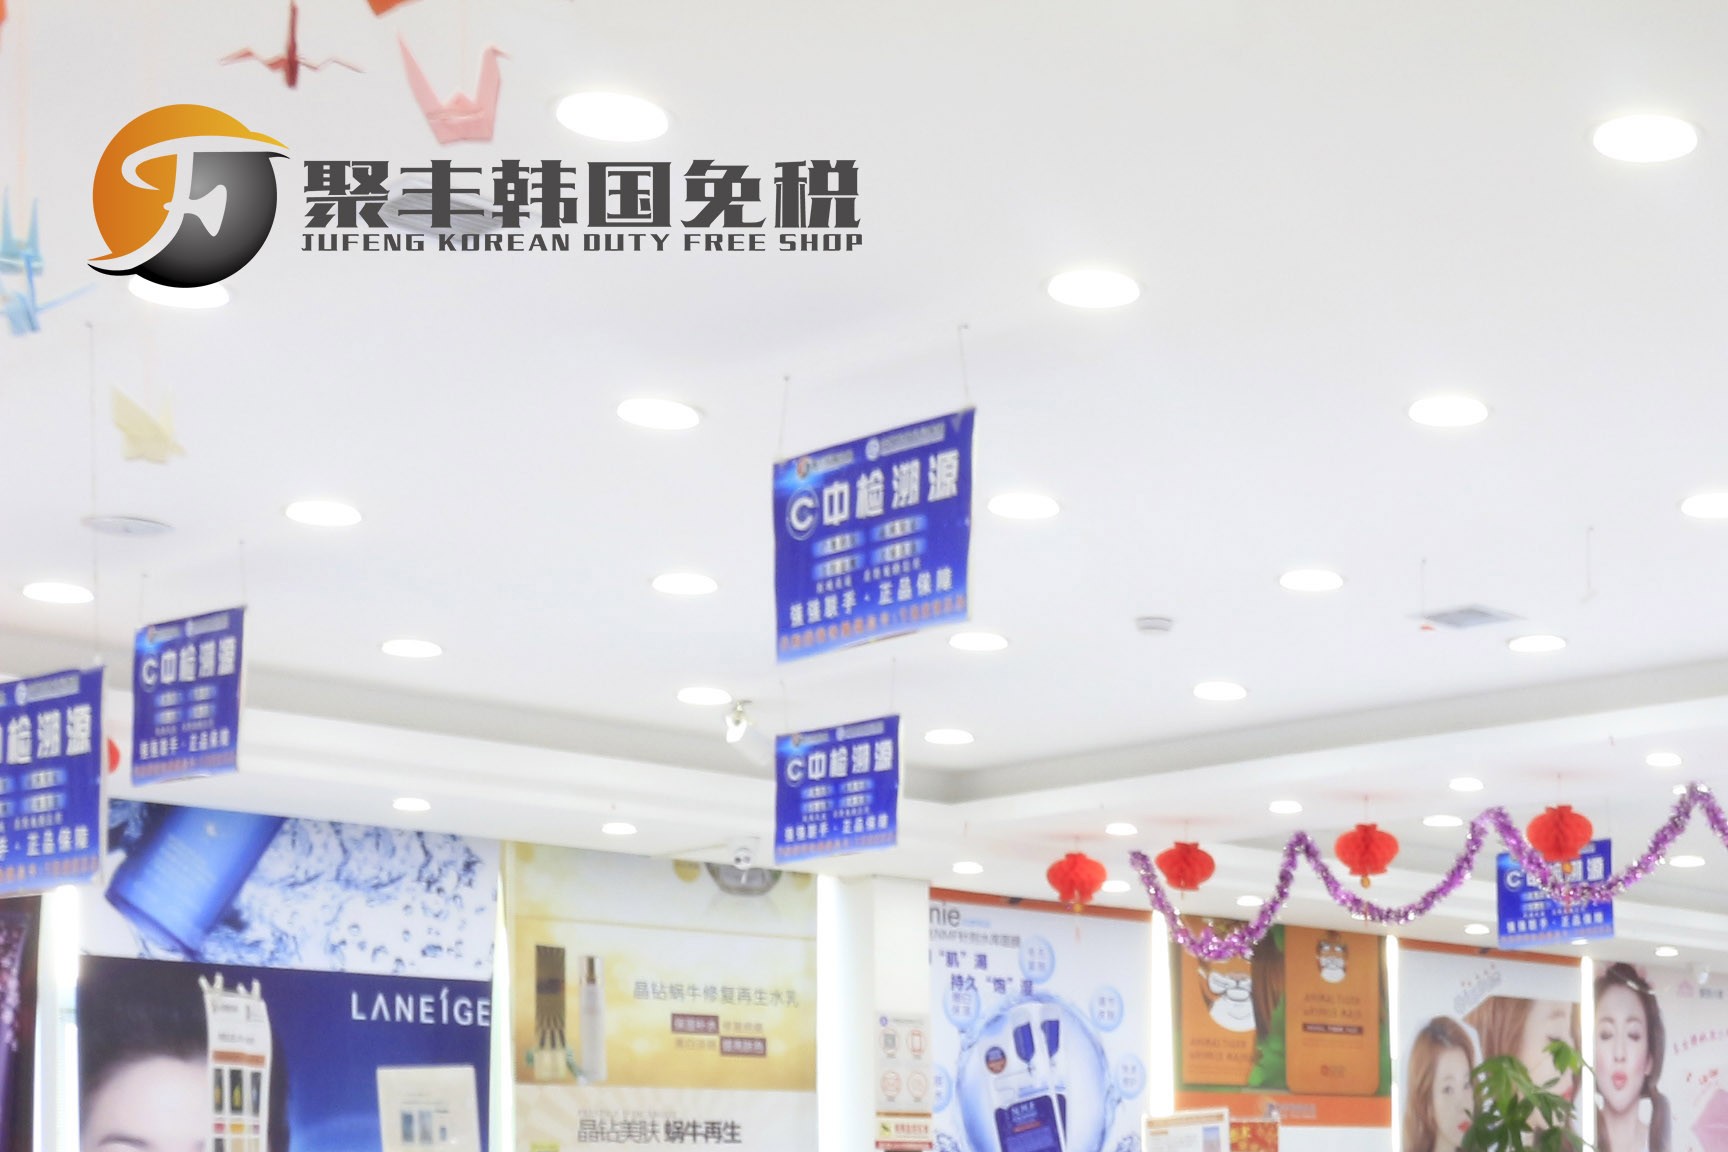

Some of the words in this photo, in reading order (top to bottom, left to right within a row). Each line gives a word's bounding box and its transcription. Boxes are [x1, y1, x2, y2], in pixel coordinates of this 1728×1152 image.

[822, 449, 960, 526] 中检溯源
[664, 1120, 743, 1144] 蜗牛再生
